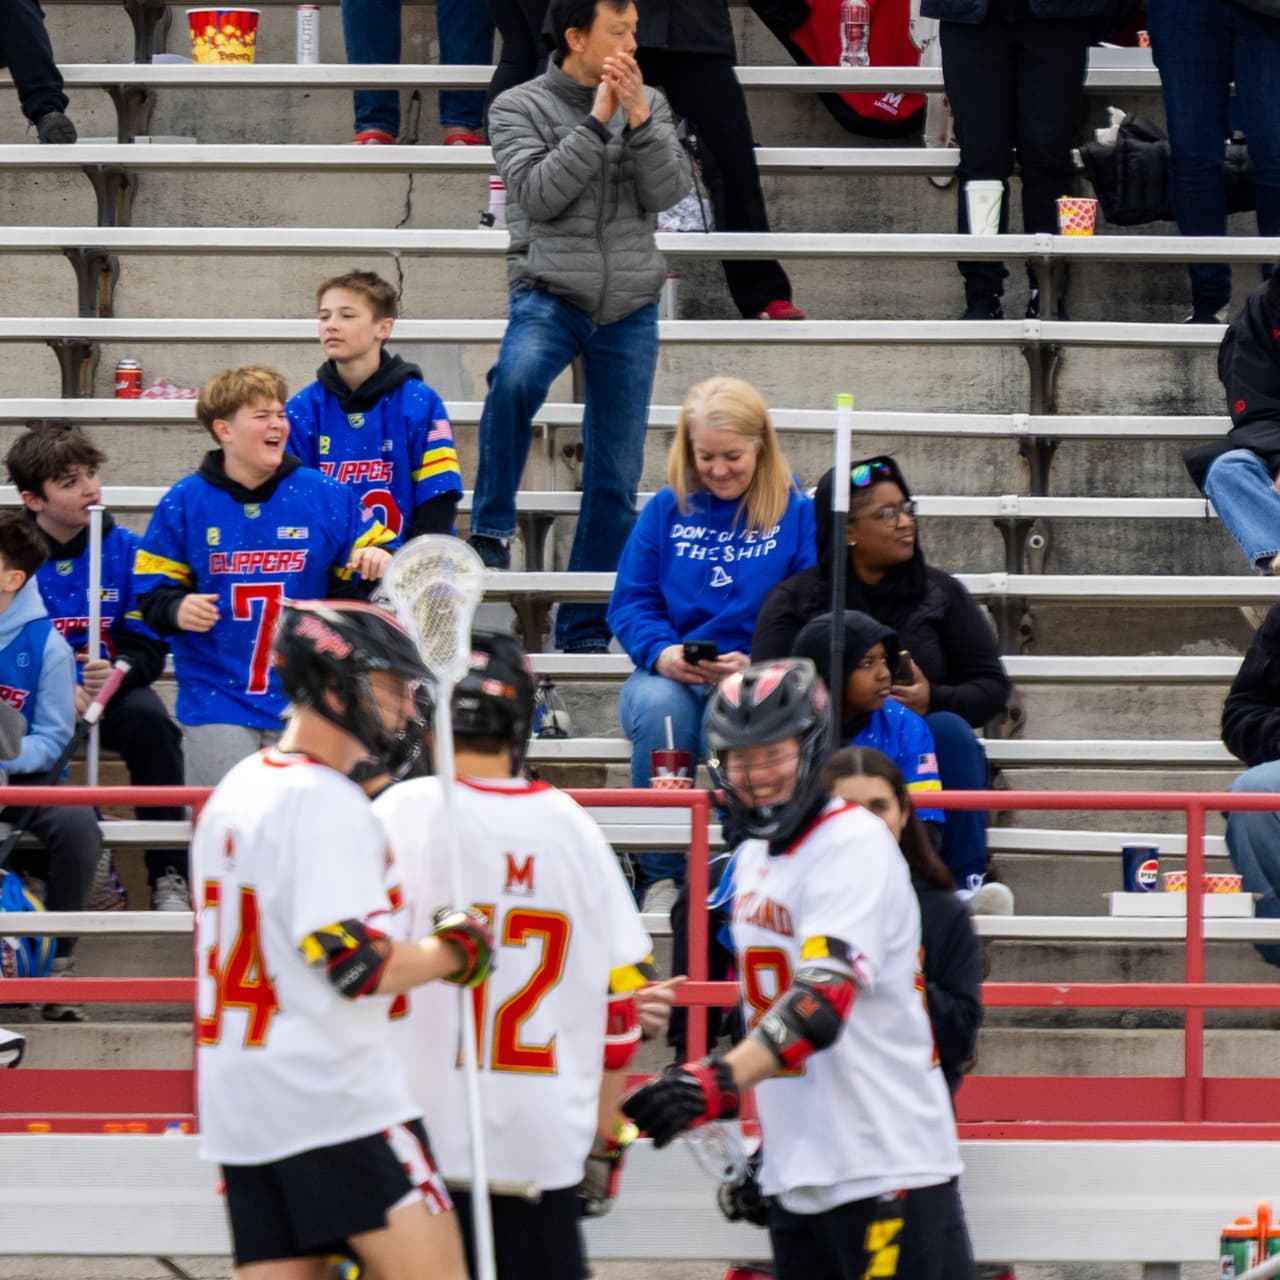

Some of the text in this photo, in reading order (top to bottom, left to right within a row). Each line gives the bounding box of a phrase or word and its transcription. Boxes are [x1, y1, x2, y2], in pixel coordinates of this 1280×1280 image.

[209, 549, 308, 575] CLIPPERS
[676, 540, 778, 562] THE SHIP
[231, 583, 284, 695] 7
[505, 853, 536, 891] M
